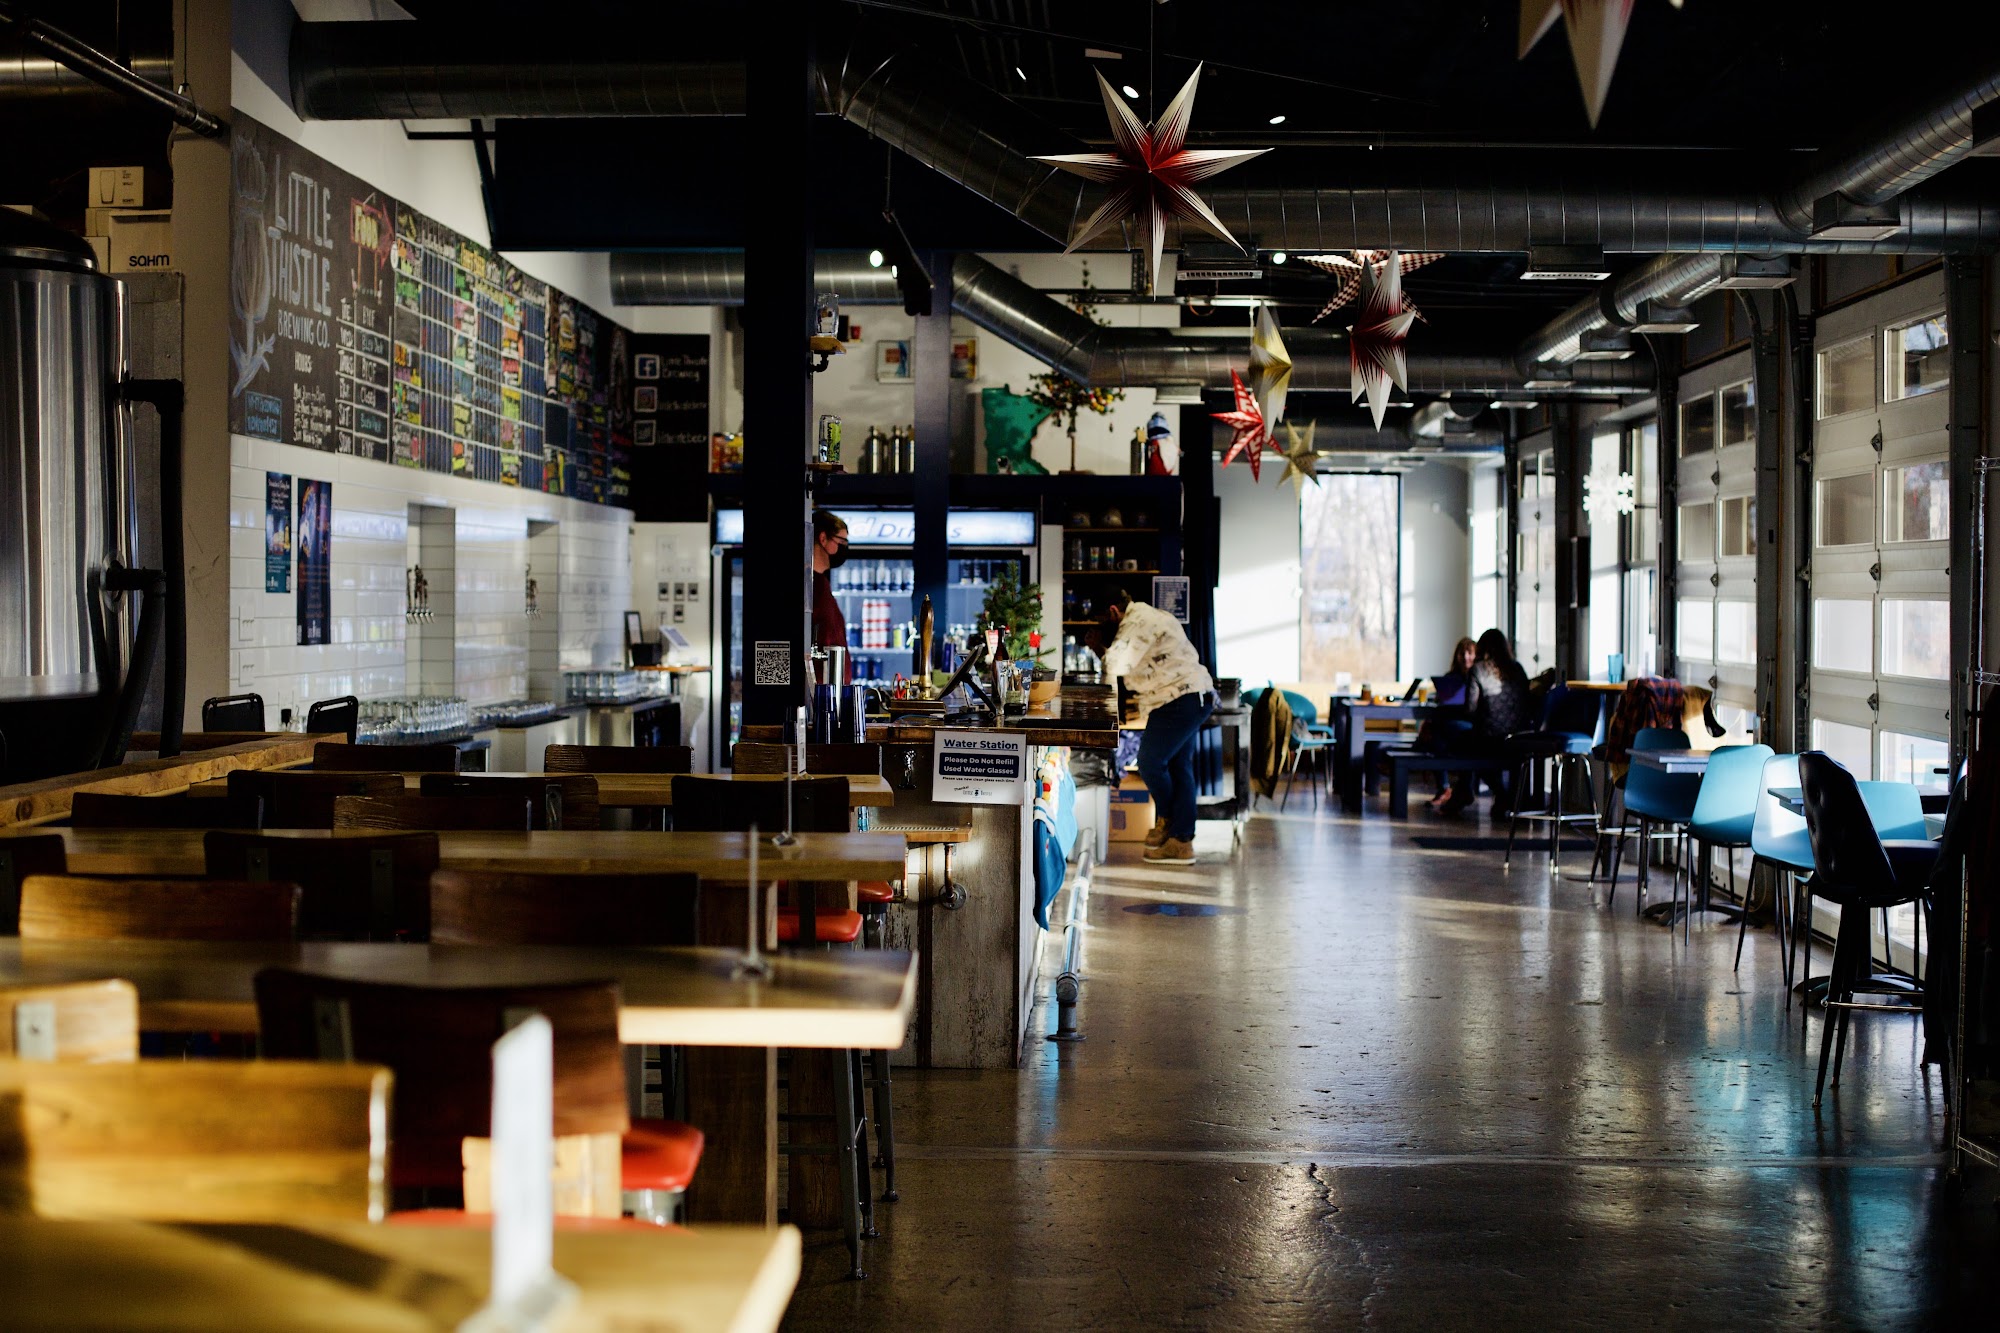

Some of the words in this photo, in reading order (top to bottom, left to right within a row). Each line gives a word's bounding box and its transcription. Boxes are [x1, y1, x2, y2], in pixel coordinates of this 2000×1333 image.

[275, 154, 333, 250] LITTLE
[268, 226, 332, 317] THISTLE
[278, 309, 314, 345] BREWING
[943, 739, 977, 748] Water
[980, 740, 1018, 750] Station
[987, 767, 1014, 775] Glasses
